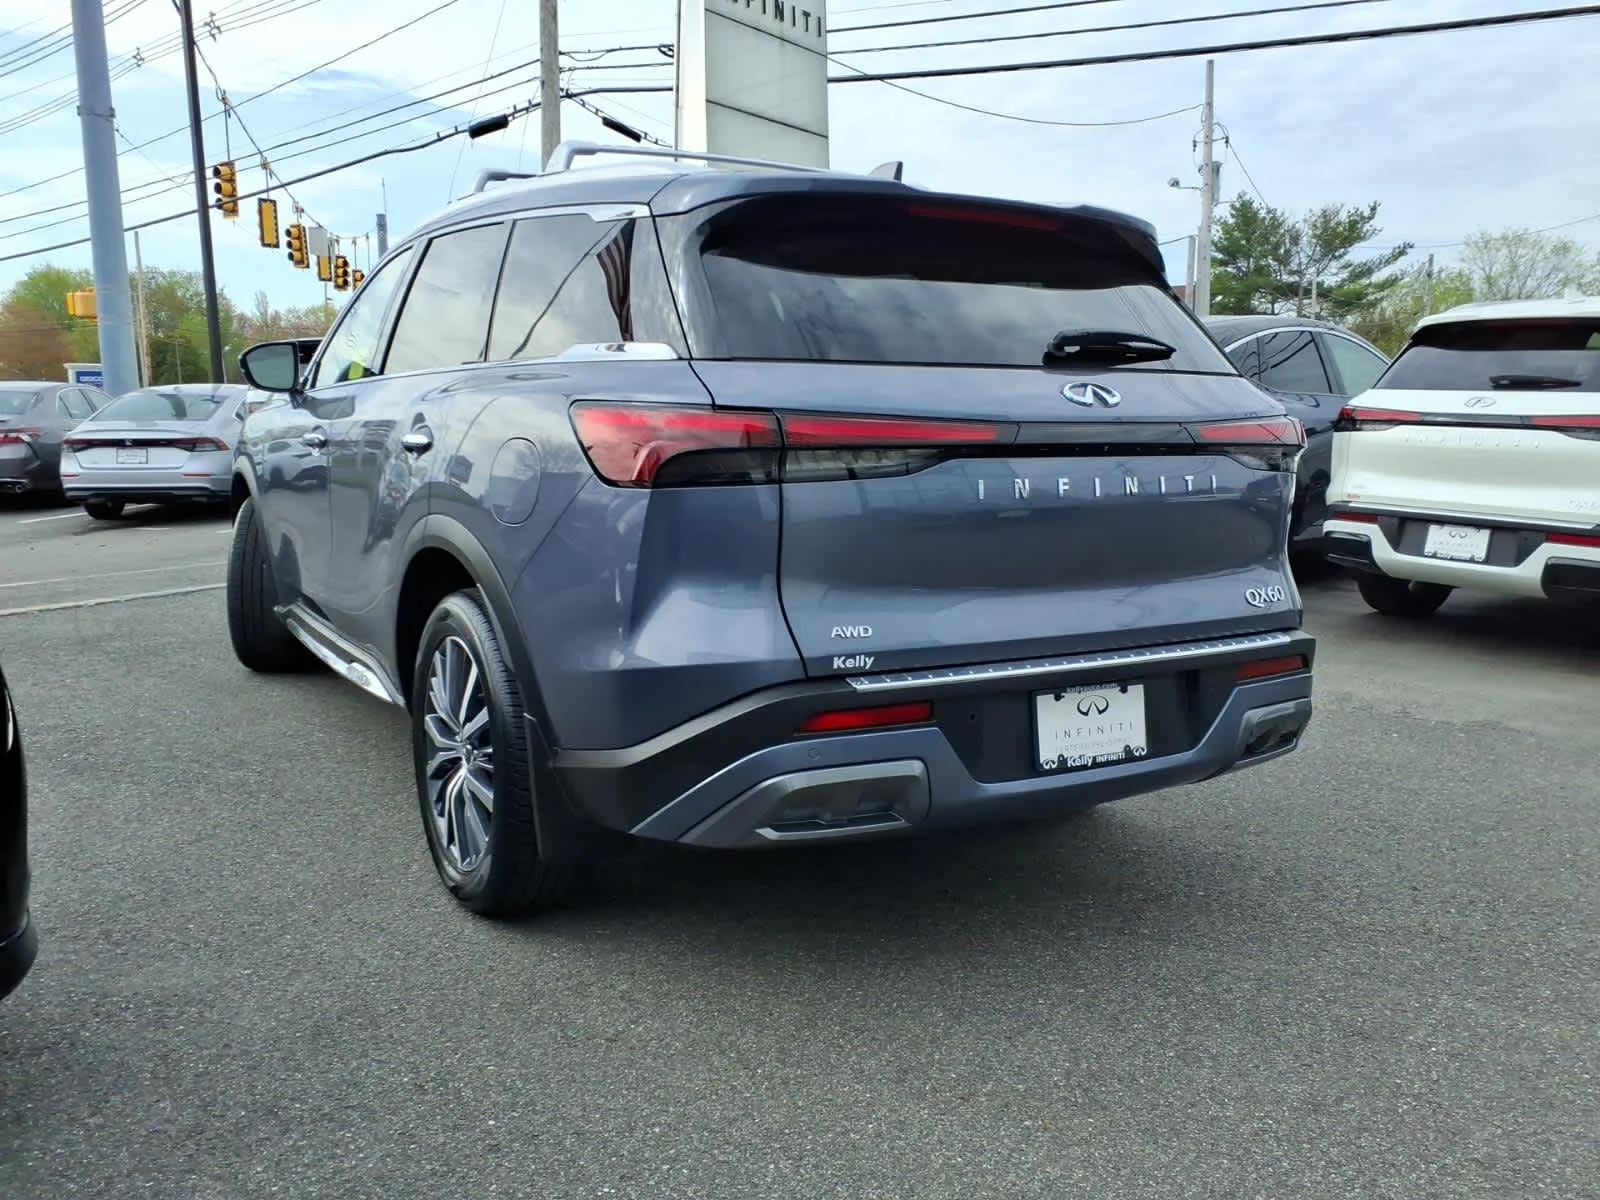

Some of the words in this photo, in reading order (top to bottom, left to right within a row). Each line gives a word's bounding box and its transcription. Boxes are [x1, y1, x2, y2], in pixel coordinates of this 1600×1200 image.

[978, 475, 1216, 500] INFINITI
[1245, 585, 1285, 608] QX60
[831, 625, 873, 638] AWD
[832, 654, 875, 669] Kelly
[1055, 719, 1133, 741] INFINITI
[1066, 754, 1094, 768] Kelly
